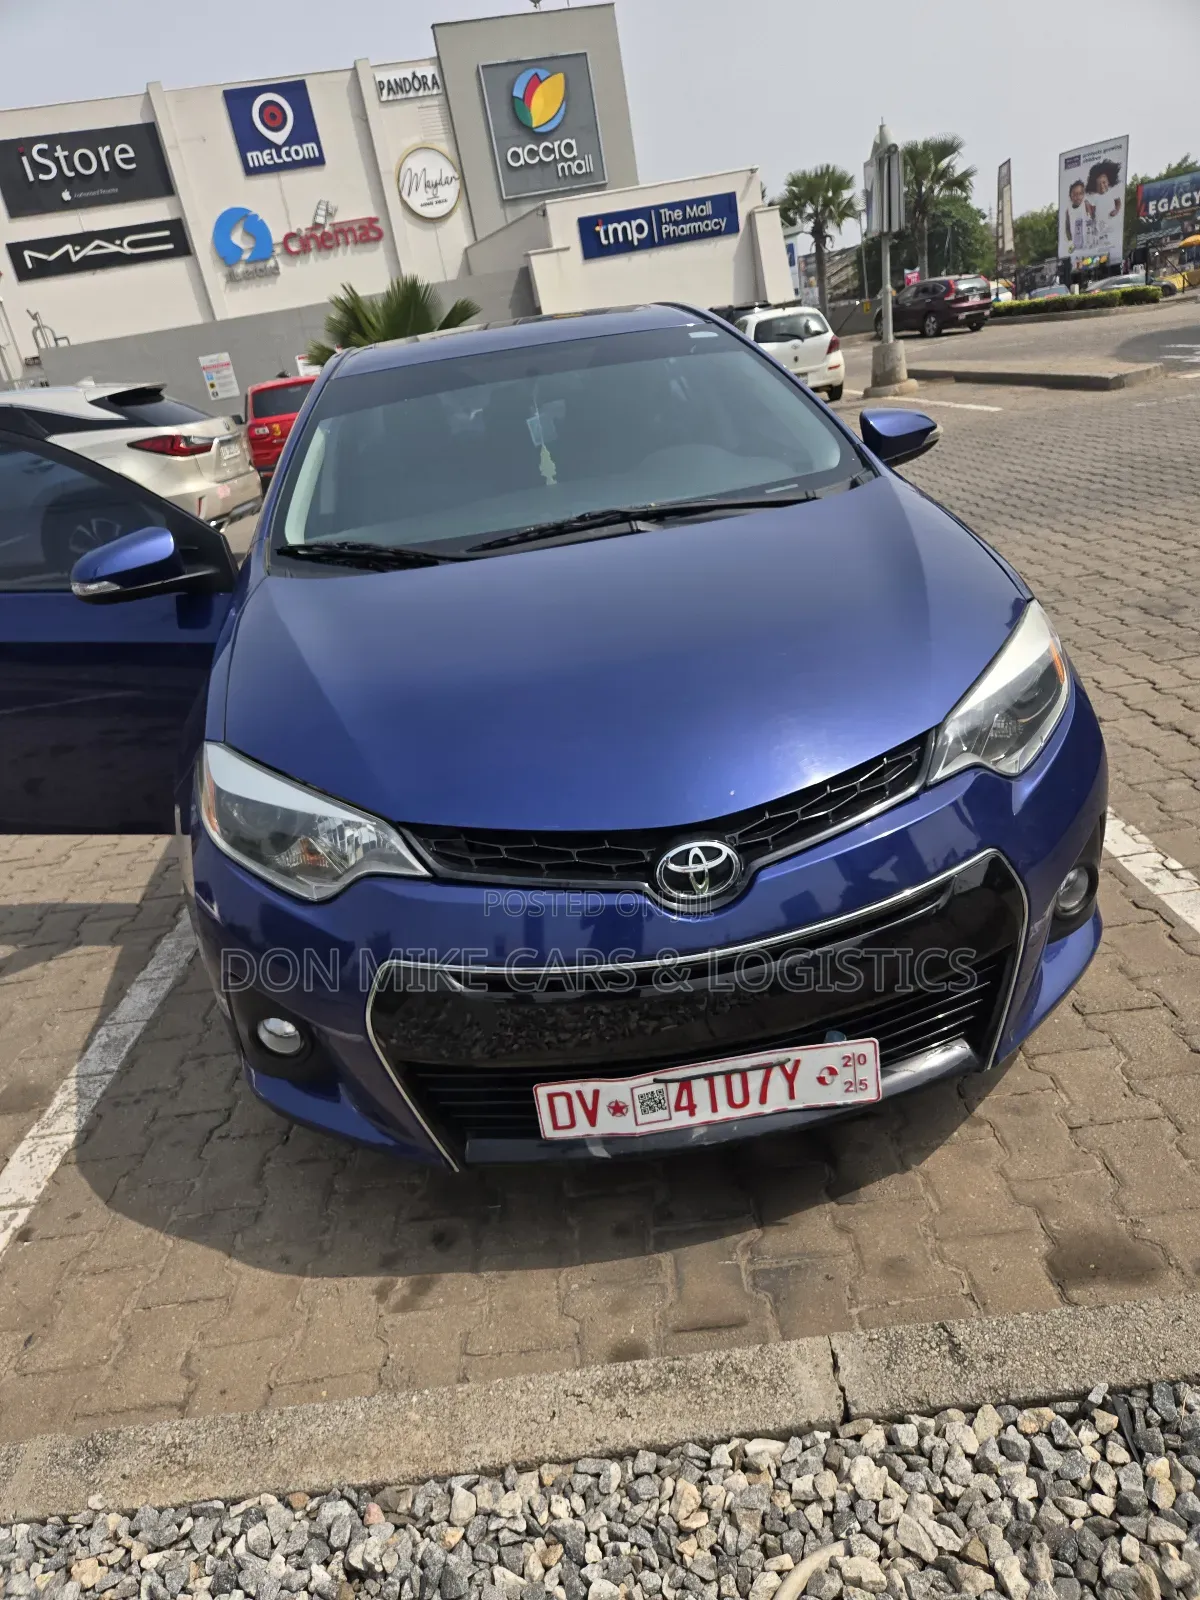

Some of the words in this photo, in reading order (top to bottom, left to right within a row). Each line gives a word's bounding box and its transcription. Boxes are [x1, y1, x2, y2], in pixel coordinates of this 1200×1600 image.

[18, 142, 137, 182] iStore
[246, 142, 319, 168] MELCOM
[507, 138, 578, 167] accra
[557, 154, 594, 177] mall
[659, 208, 683, 223] The
[686, 201, 712, 219] Mall
[283, 216, 384, 257] Cinemas
[595, 218, 649, 246] tmp
[661, 216, 727, 239] Pharmacy
[547, 1089, 600, 1131] DV
[674, 1058, 801, 1118] 4107Y
[842, 1053, 867, 1068] 20
[844, 1078, 868, 1093] 25
